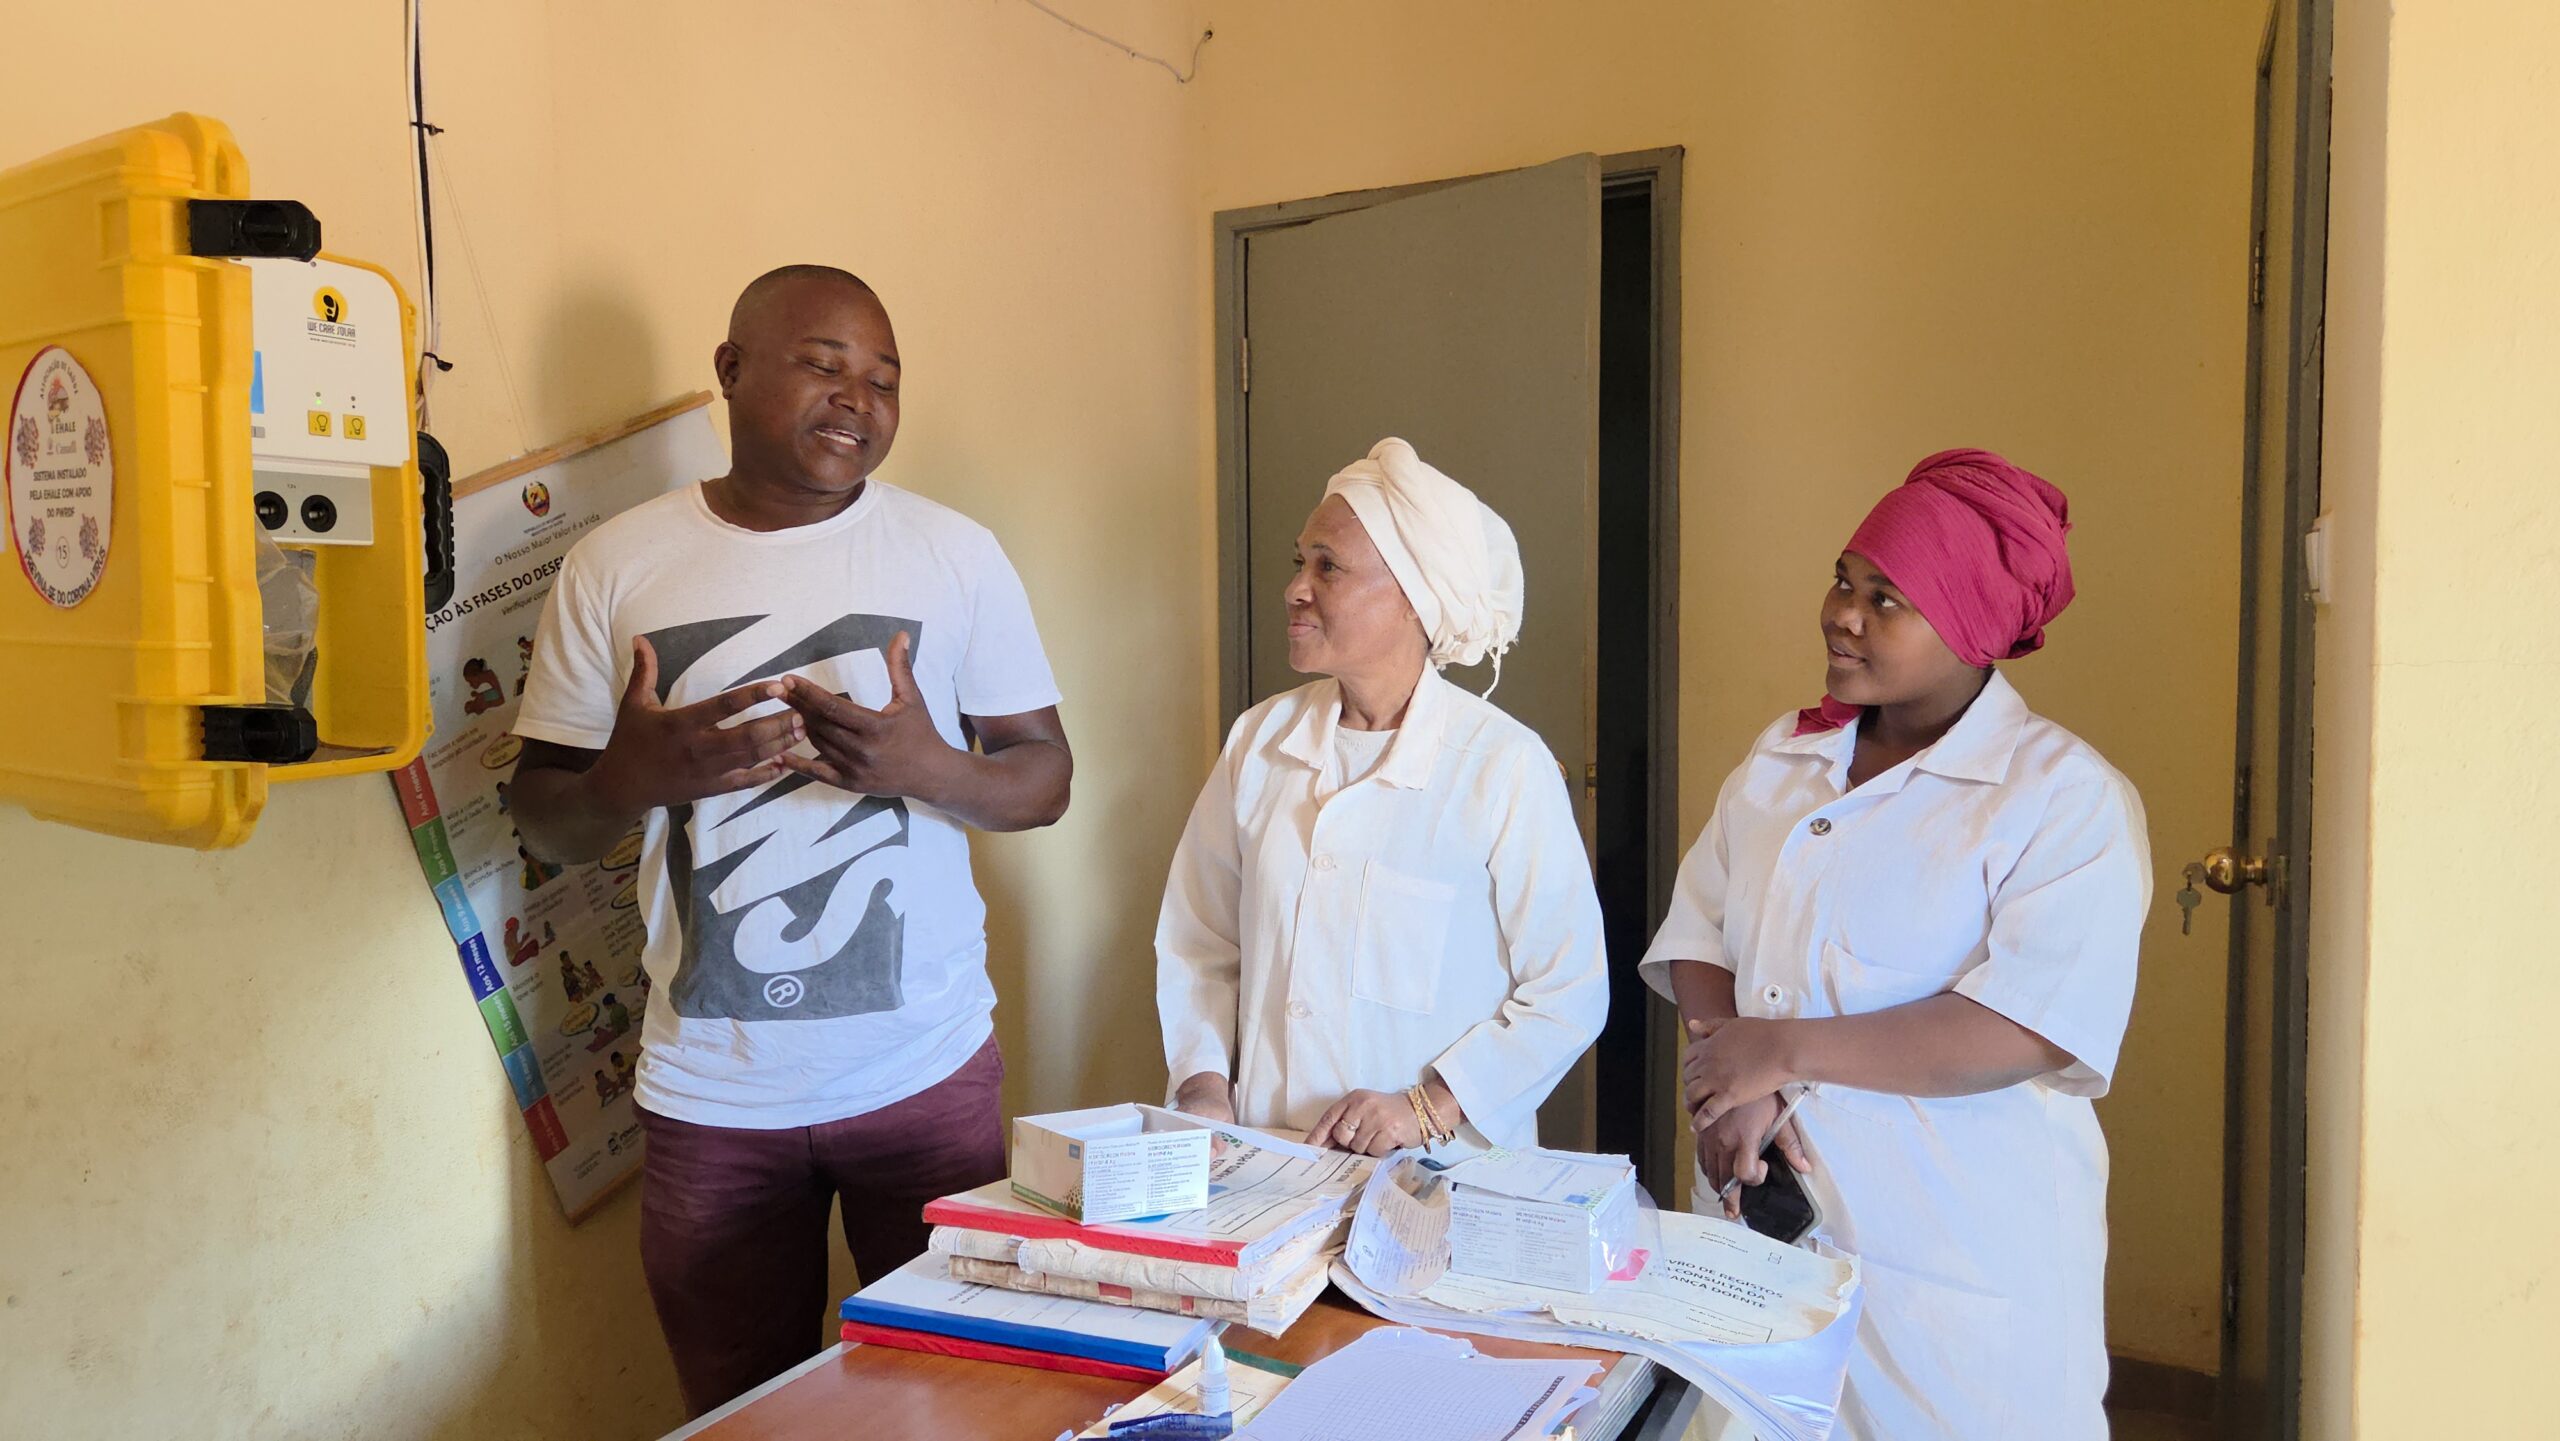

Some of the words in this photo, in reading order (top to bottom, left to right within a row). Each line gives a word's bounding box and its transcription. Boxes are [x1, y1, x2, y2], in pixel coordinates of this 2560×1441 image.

[307, 321, 317, 332] WE
[319, 323, 335, 335] CARE
[337, 326, 356, 337] SOLAR
[55, 421, 76, 434] EHALE
[33, 470, 56, 482] SISTEMA
[56, 467, 87, 480] INSTALADO
[29, 490, 43, 501] PELA
[43, 489, 61, 500] EHALE
[62, 488, 74, 499] COM
[75, 486, 92, 498] APOIO
[46, 508, 54, 518] DO
[494, 555, 503, 566] O
[503, 546, 531, 562] Nosso
[531, 535, 552, 550] Maior
[552, 526, 572, 540] Valor
[583, 513, 600, 526] Vida
[58, 544, 68, 560] 15
[56, 591, 66, 604] DO
[453, 600, 473, 617] ÀS
[472, 581, 512, 608] FASES
[511, 573, 532, 591] DO
[408, 764, 423, 793] meses
[418, 800, 430, 817] Aos
[468, 938, 482, 965] meses
[476, 964, 486, 976] 12
[482, 975, 495, 992] Aos
[492, 995, 510, 1022] meses
[1664, 1258, 1696, 1269] VRO
[1699, 1266, 1717, 1275] DE
[1719, 1272, 1784, 1299] REGISTOS
[1675, 1268, 1743, 1293] CONSULTA
[1747, 1290, 1767, 1301] DA
[1648, 1270, 1707, 1290] CANÇA
[1711, 1286, 1767, 1309] DOENTE
